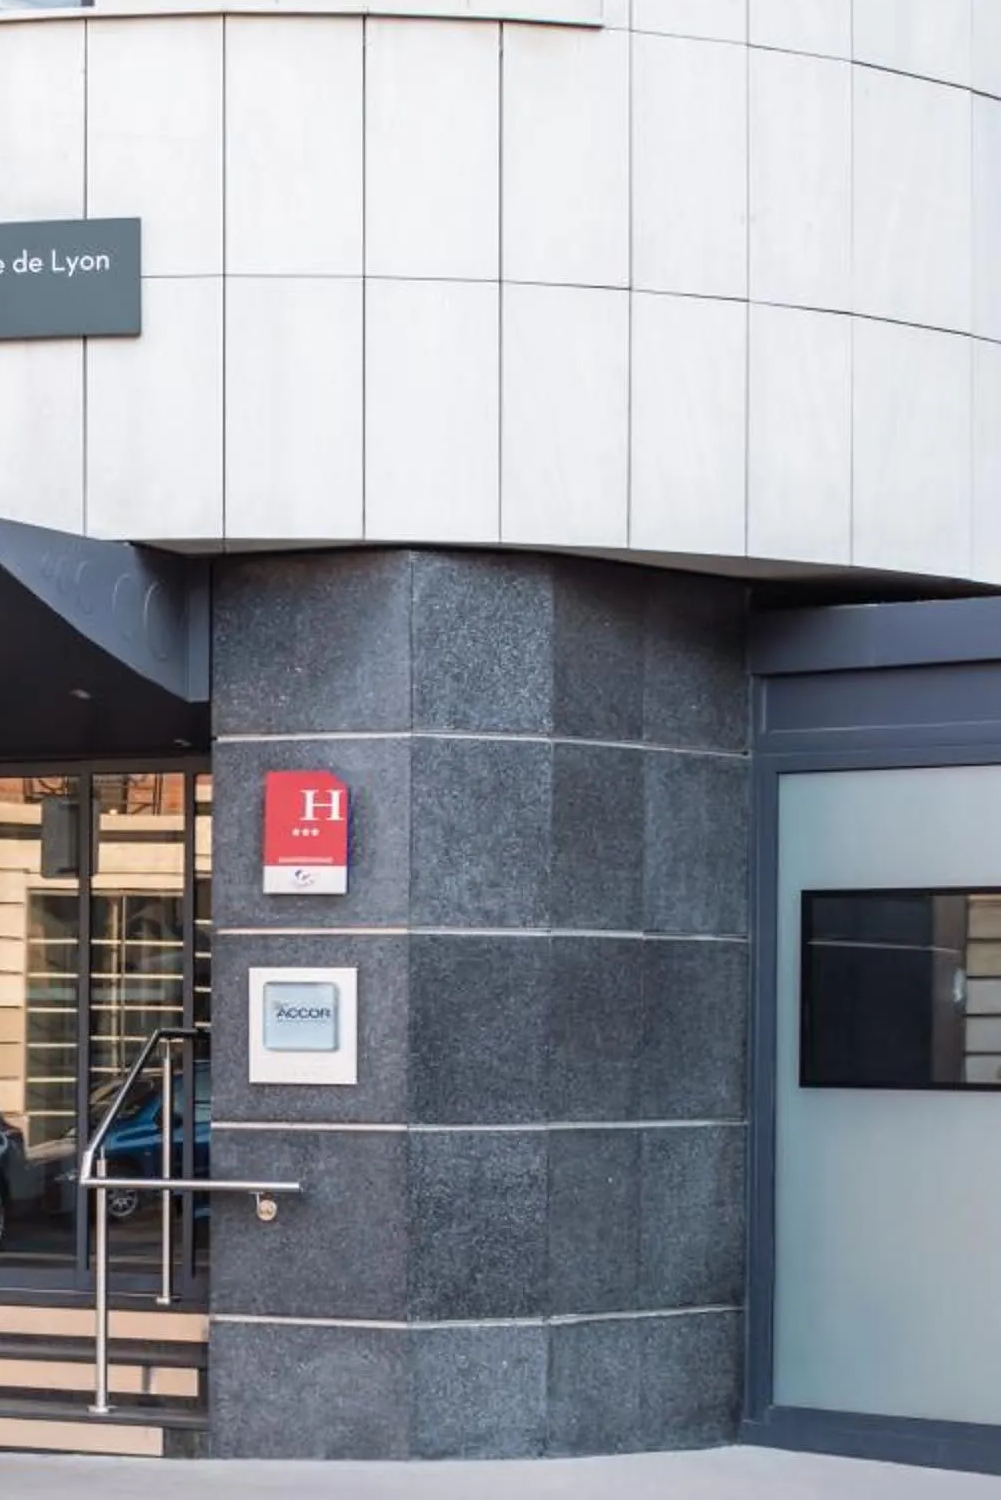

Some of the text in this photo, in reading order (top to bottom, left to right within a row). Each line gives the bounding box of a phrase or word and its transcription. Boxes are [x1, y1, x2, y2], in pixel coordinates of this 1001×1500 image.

[12, 249, 44, 273] de
[51, 249, 110, 277] Lyon
[299, 788, 345, 822] H
[276, 1007, 331, 1019] ACCOR
